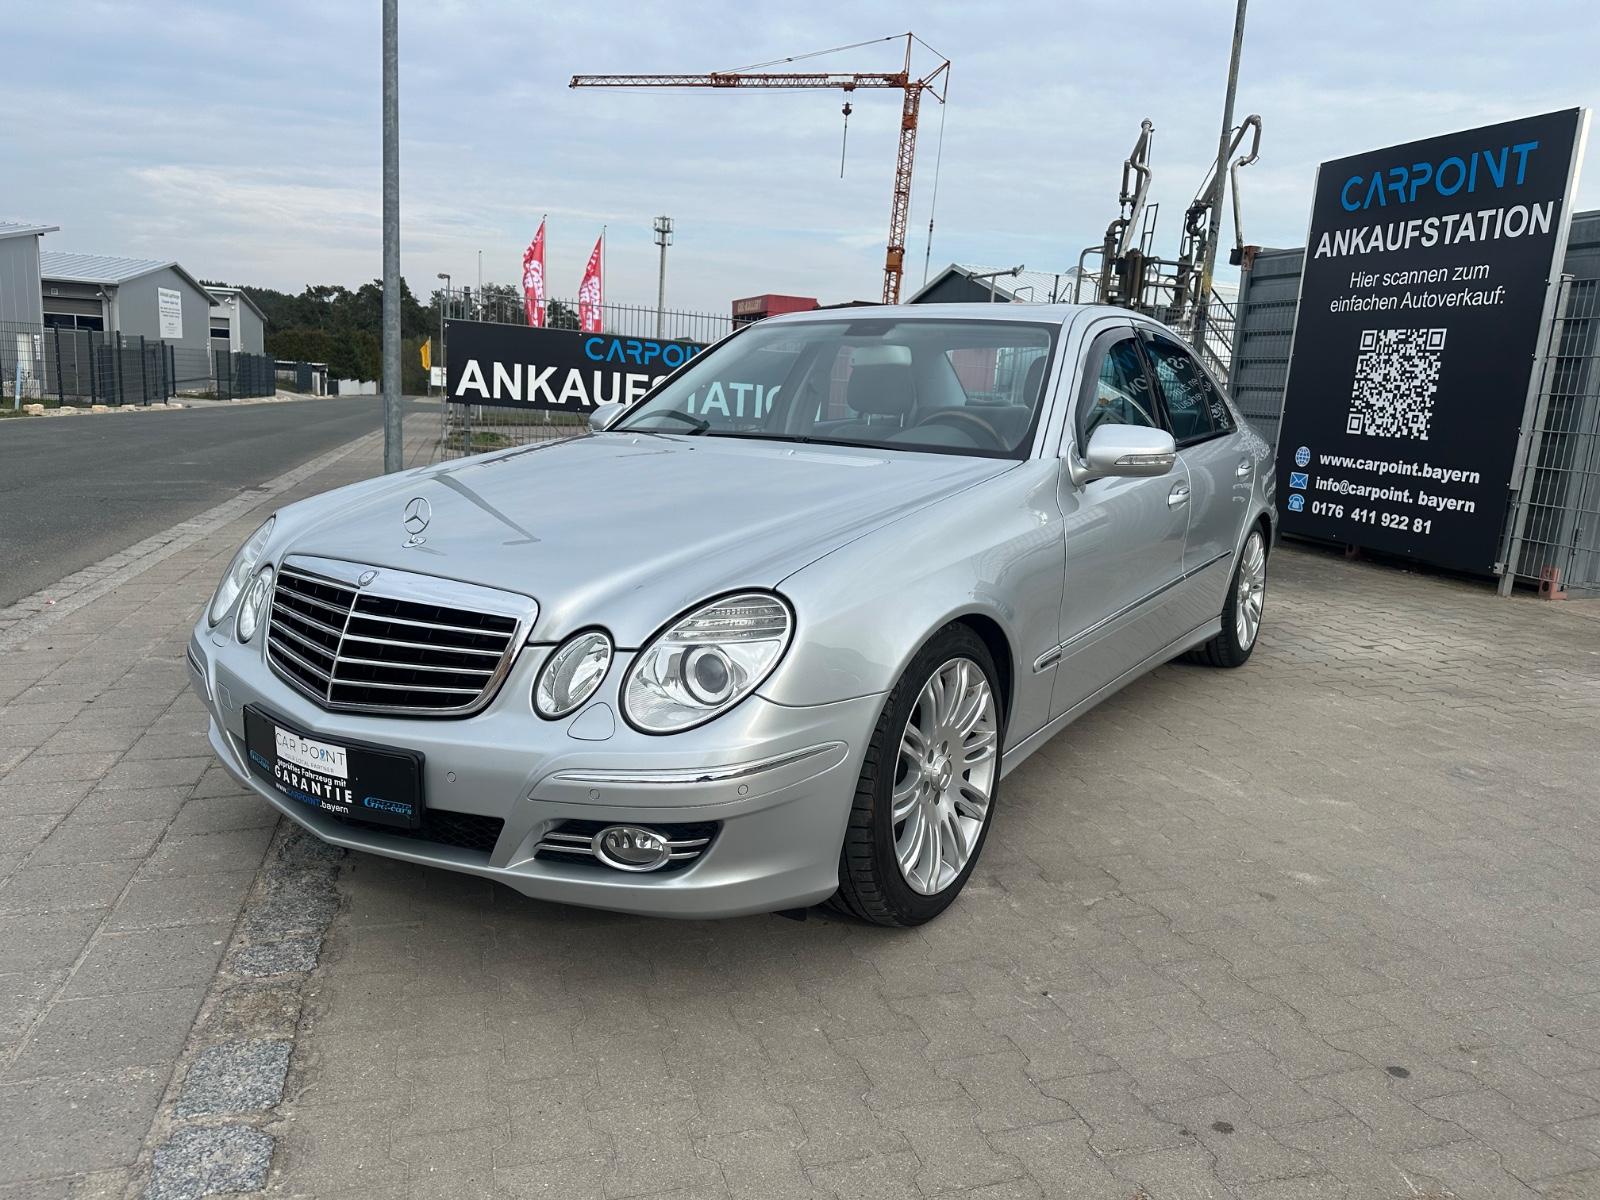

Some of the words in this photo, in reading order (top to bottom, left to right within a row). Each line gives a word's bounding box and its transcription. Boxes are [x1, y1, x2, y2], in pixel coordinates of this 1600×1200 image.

[1341, 141, 1539, 212] CARPOINT
[1314, 201, 1554, 258] ANKAUFSTATION
[1350, 270, 1379, 288] Hier
[1382, 267, 1447, 286] scannen
[1453, 264, 1490, 281] zum
[1330, 290, 1397, 312] einfachen
[1400, 286, 1506, 310] Autoverkauf:
[1319, 453, 1480, 484] www.carpoint.bayern
[1315, 476, 1413, 504] info@carpoint.
[1418, 491, 1476, 513] bayern
[1312, 501, 1344, 519] 0176
[1351, 508, 1375, 524] 411
[1381, 513, 1408, 531] 922
[1412, 518, 1432, 535] 81
[275, 732, 296, 753] CAR
[274, 764, 353, 804] GARANTIE
[301, 767, 333, 786] Fahrzeug
[333, 778, 347, 788] mit
